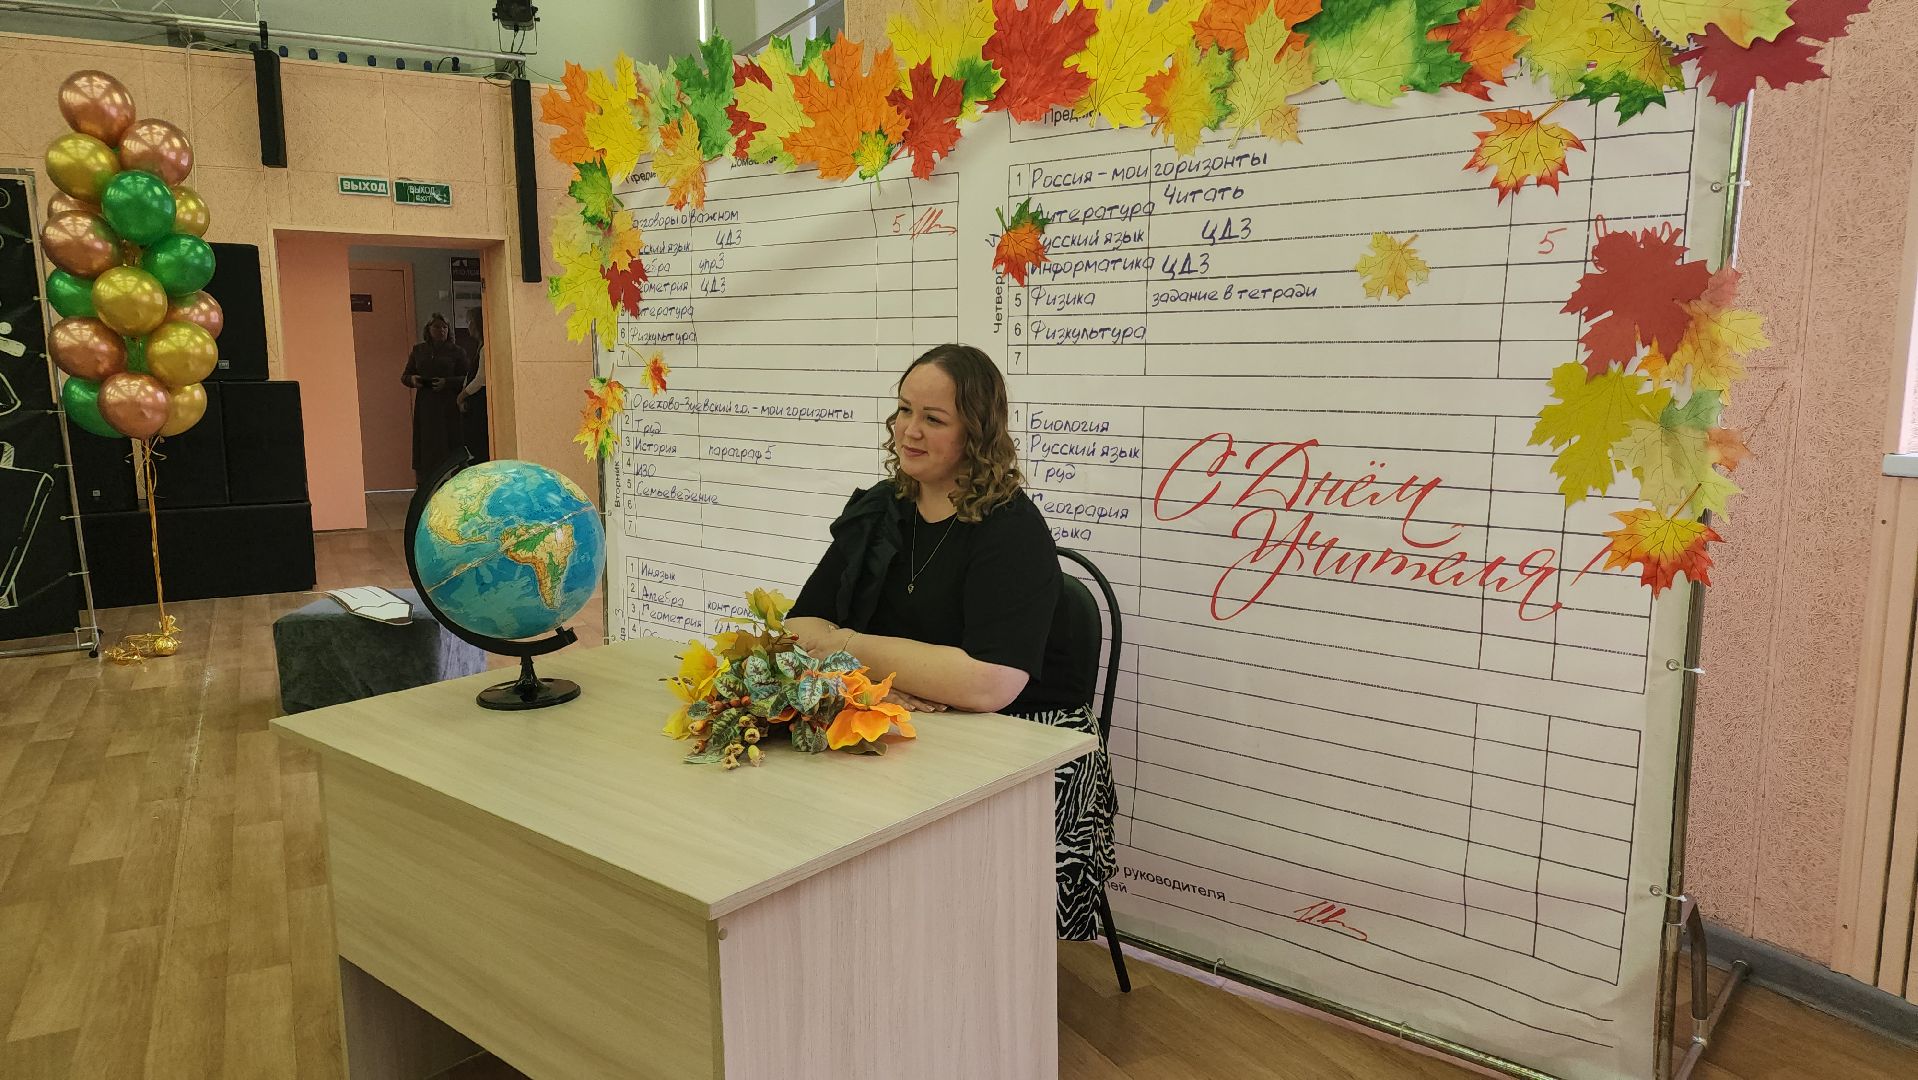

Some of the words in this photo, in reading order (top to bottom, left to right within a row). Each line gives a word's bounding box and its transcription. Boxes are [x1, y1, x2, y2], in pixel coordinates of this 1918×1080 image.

[1044, 108, 1096, 126] Пред
[1016, 172, 1021, 187] 1
[1031, 167, 1093, 190] Россия
[1111, 163, 1149, 181] мои
[1154, 152, 1268, 181] горизонты
[342, 180, 387, 194] ВЫХОД
[408, 185, 435, 195] ВЫХОД
[1164, 183, 1245, 206] Читать
[632, 211, 679, 230] азговоры
[892, 213, 906, 234] 5
[1042, 229, 1099, 253] усский
[1103, 229, 1145, 251] язык
[1537, 227, 1568, 255] 5
[1014, 292, 1022, 308] 5
[1030, 286, 1097, 311] Физика
[1151, 289, 1219, 307] задание
[1223, 284, 1234, 300] в
[1237, 284, 1318, 303] тетради
[620, 327, 626, 339] 6
[630, 326, 697, 345] Физкультура
[1014, 322, 1022, 337] 6
[1030, 319, 1146, 346] Физкультура
[1014, 351, 1021, 366] 7
[624, 414, 630, 425] 2
[786, 406, 854, 422] горизонты
[1014, 409, 1019, 422] 1
[1030, 410, 1110, 432] Биология
[625, 436, 631, 447] 3
[634, 437, 677, 456] История
[1030, 433, 1097, 458] Русский
[1100, 445, 1140, 463] язык
[626, 457, 631, 467] 4
[635, 463, 656, 477] ИЗО
[1030, 460, 1076, 483] Труд
[1154, 432, 1237, 522] С
[1232, 437, 1463, 549] Днём
[630, 562, 634, 573] 1
[630, 582, 636, 593] 2
[642, 603, 702, 629] Геометрия
[1123, 866, 1226, 902] руководителя
